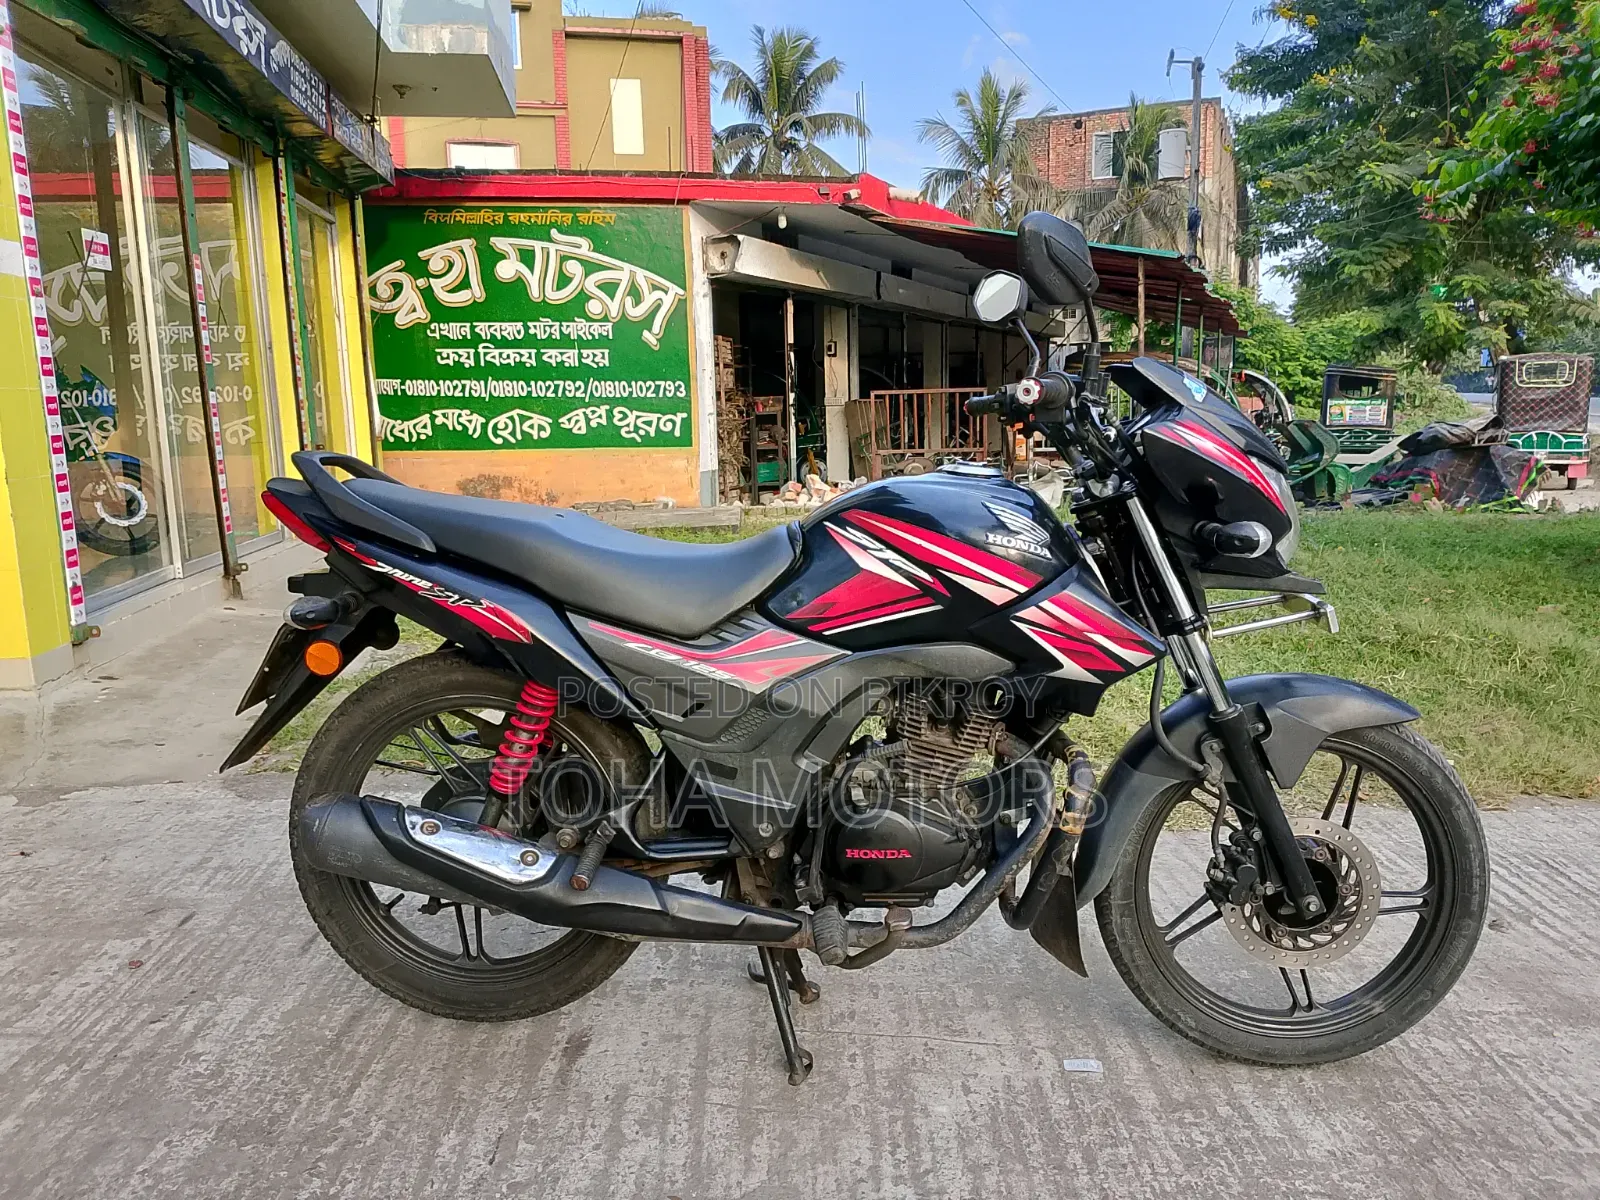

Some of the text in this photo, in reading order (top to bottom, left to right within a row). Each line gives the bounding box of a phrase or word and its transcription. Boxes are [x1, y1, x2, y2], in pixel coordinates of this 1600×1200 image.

[423, 209, 504, 225] বিসমিল্লাহির
[507, 209, 573, 226] রহমানির
[427, 320, 471, 340] এখানে
[473, 321, 525, 341] ব্যবহৃত
[432, 408, 486, 439] মধ্যে
[487, 408, 551, 444] হোক
[558, 404, 610, 434] স্বপ্ন
[612, 406, 688, 443] পূরণ
[984, 532, 1053, 560] HONDA
[845, 848, 912, 859] HONDA
